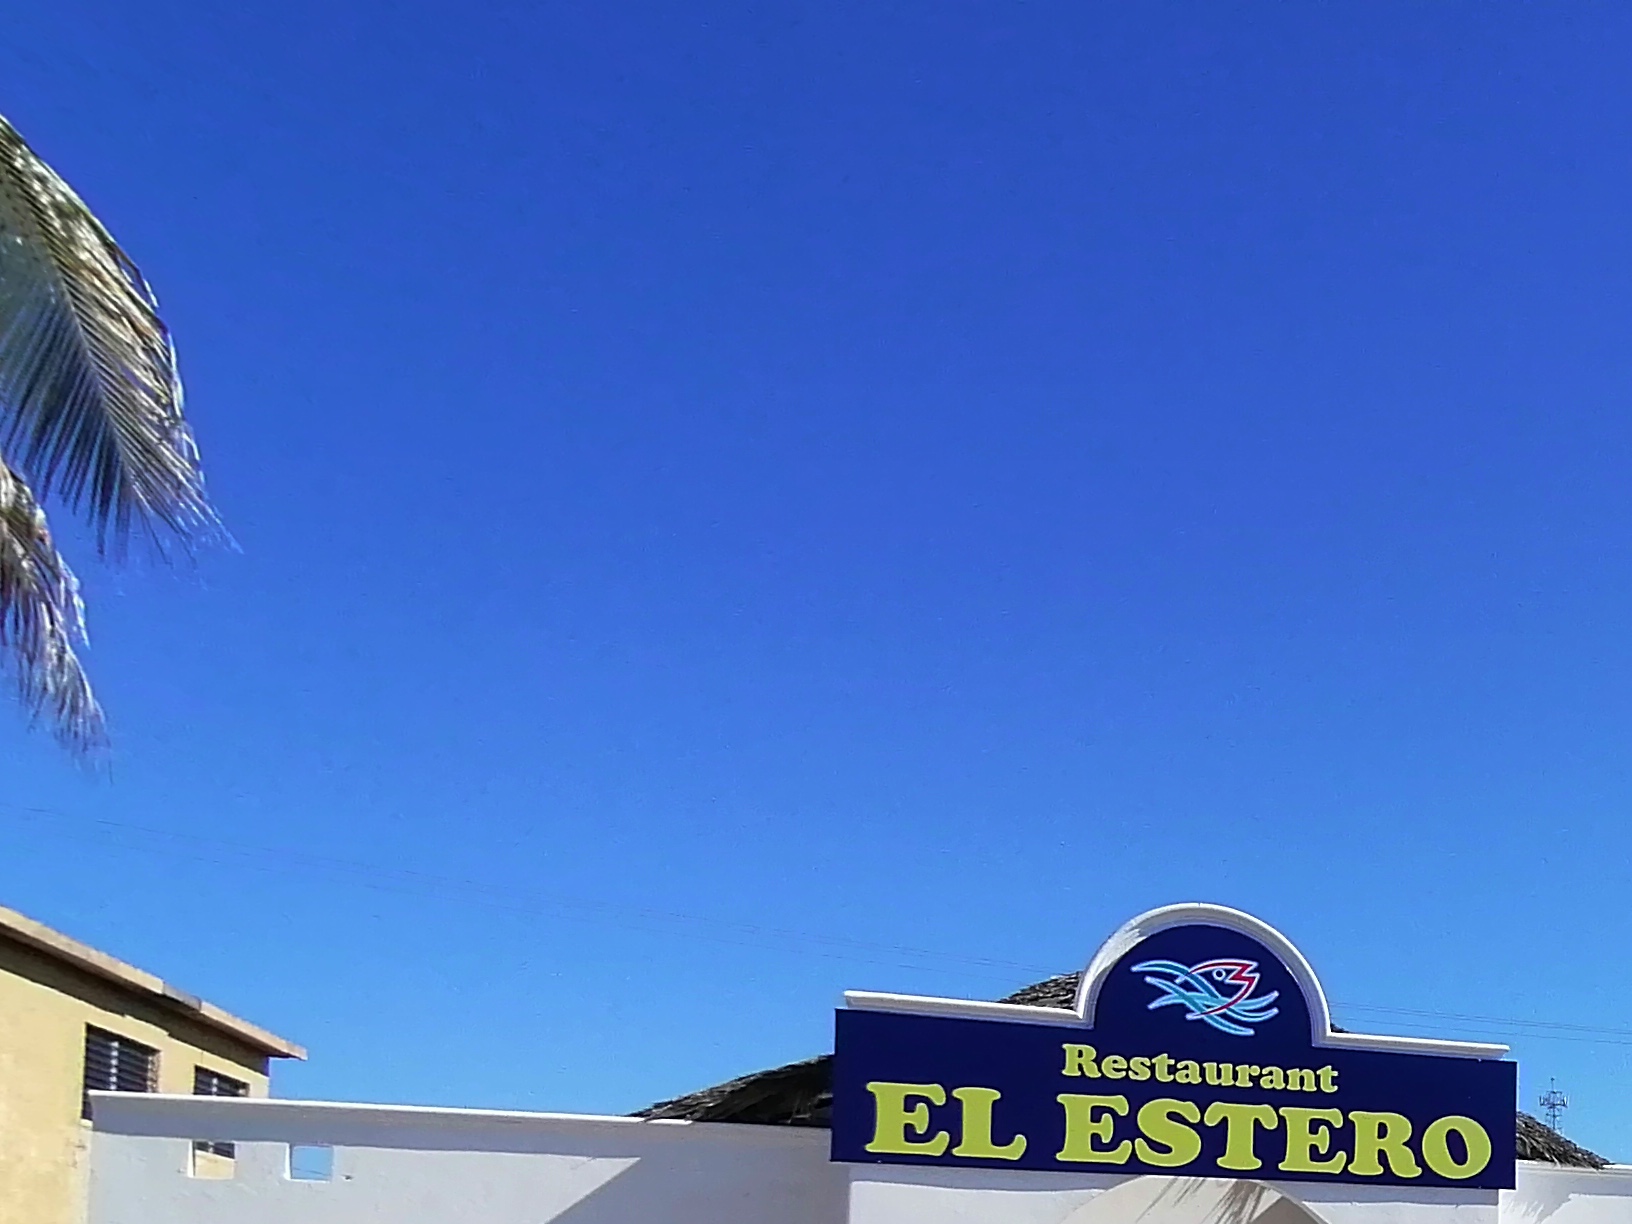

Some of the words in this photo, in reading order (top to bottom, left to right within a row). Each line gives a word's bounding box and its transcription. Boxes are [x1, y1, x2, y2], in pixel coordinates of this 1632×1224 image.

[1062, 1043, 1338, 1093] Restaurant
[865, 1081, 1027, 1161] EL
[1055, 1093, 1493, 1180] ESTERO
